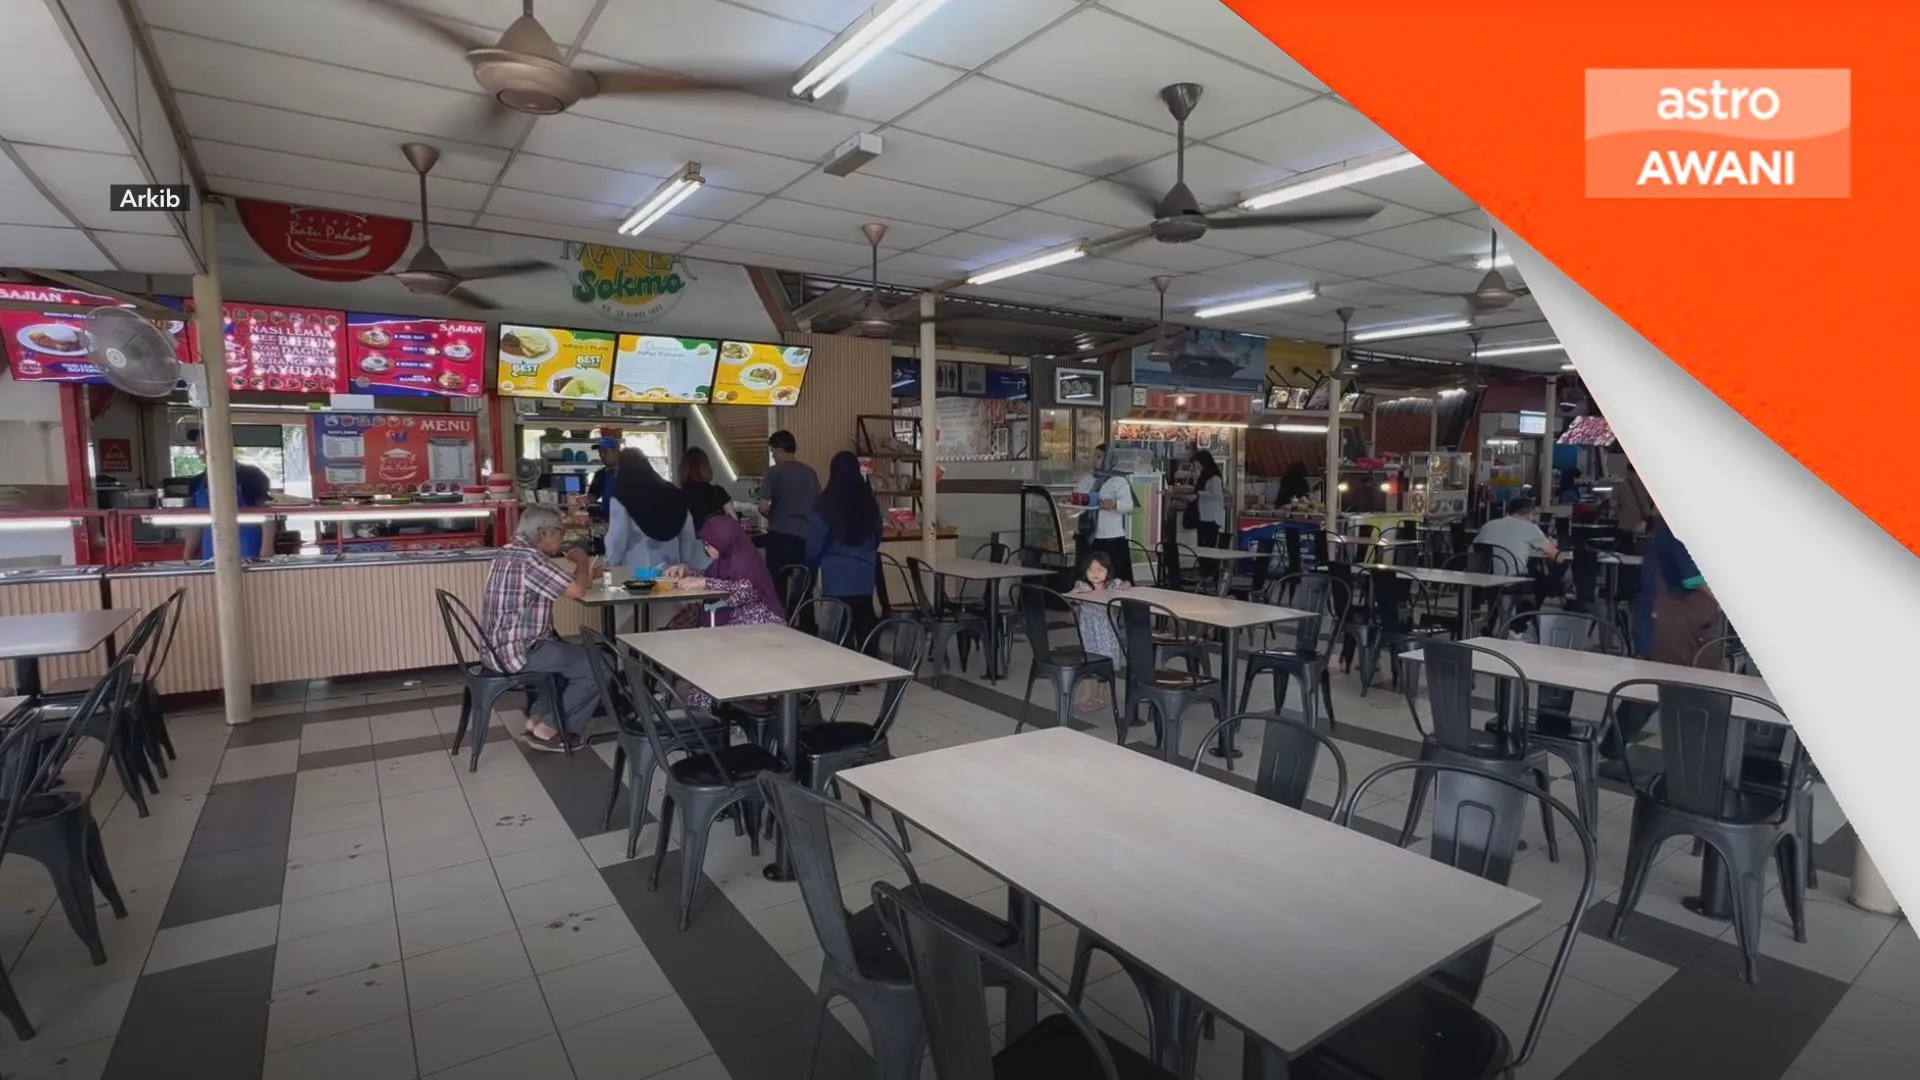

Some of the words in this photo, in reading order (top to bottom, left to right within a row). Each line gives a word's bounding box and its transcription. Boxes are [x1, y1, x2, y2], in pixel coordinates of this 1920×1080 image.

[572, 266, 686, 303] Sokmo
[0, 289, 62, 302] SAJIAN
[250, 325, 284, 335] NASI
[440, 323, 483, 333] SAJIAN
[420, 419, 471, 432] MENU
